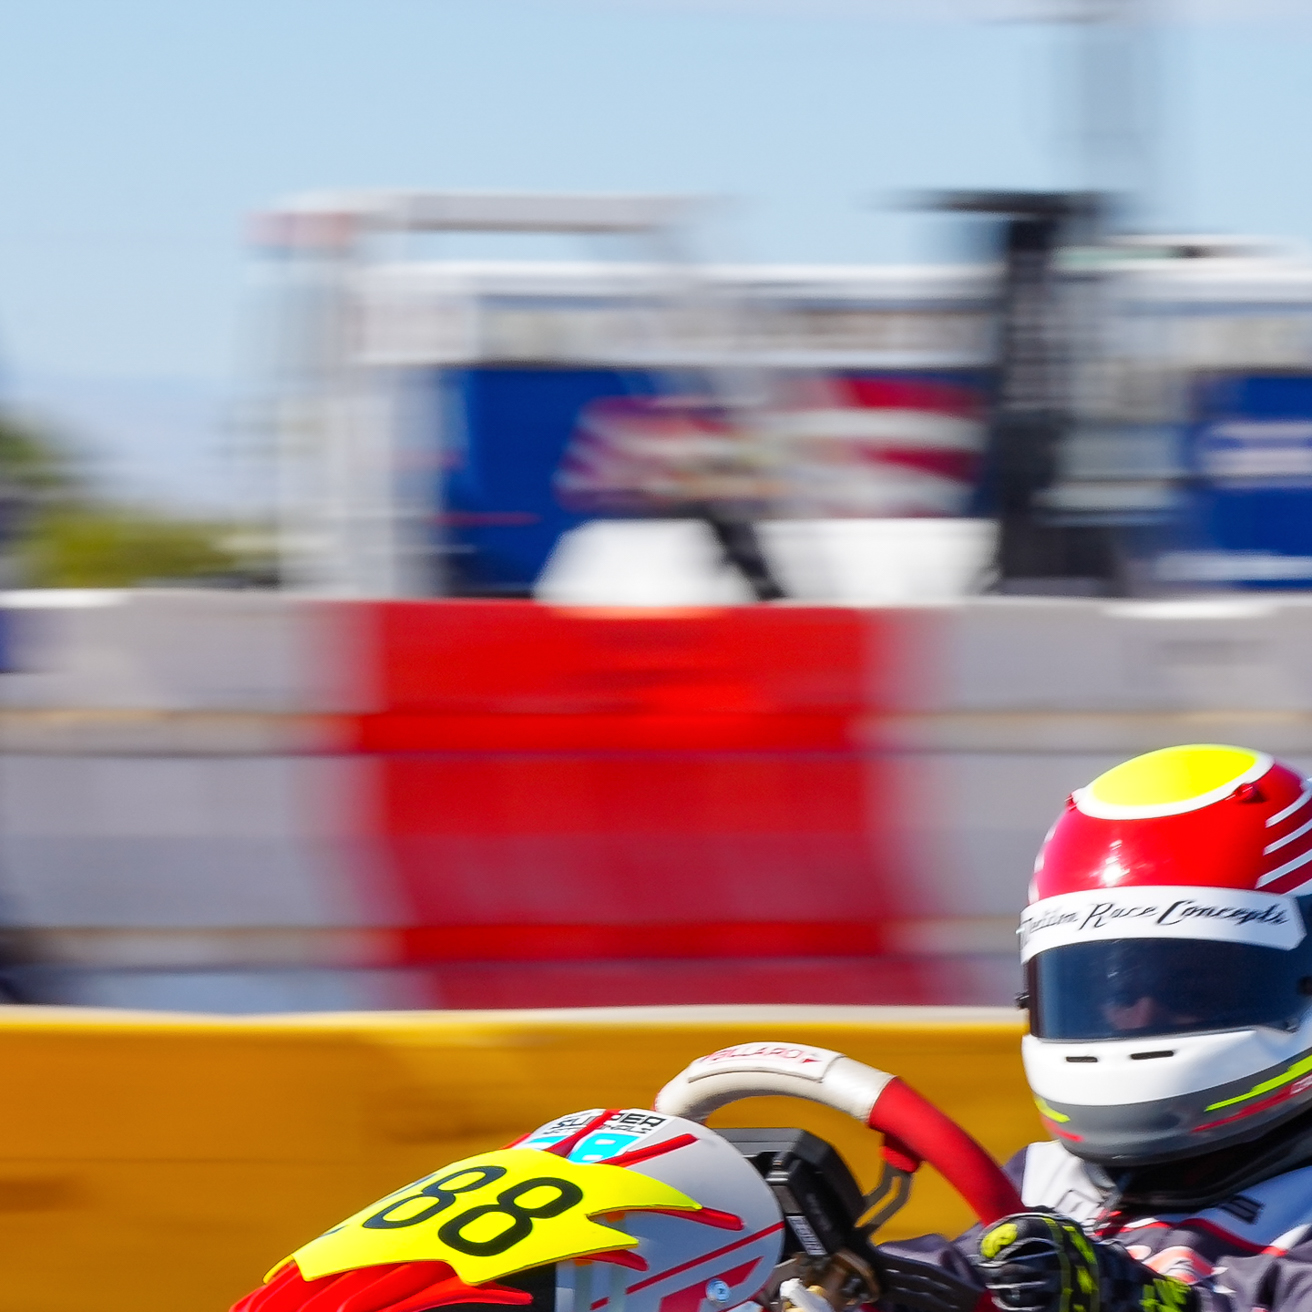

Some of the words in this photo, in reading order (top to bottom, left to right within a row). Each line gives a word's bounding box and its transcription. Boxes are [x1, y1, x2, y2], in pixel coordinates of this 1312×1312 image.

[1079, 902, 1156, 931] Race
[1156, 900, 1290, 926] Concepts
[320, 1165, 584, 1257] 88
